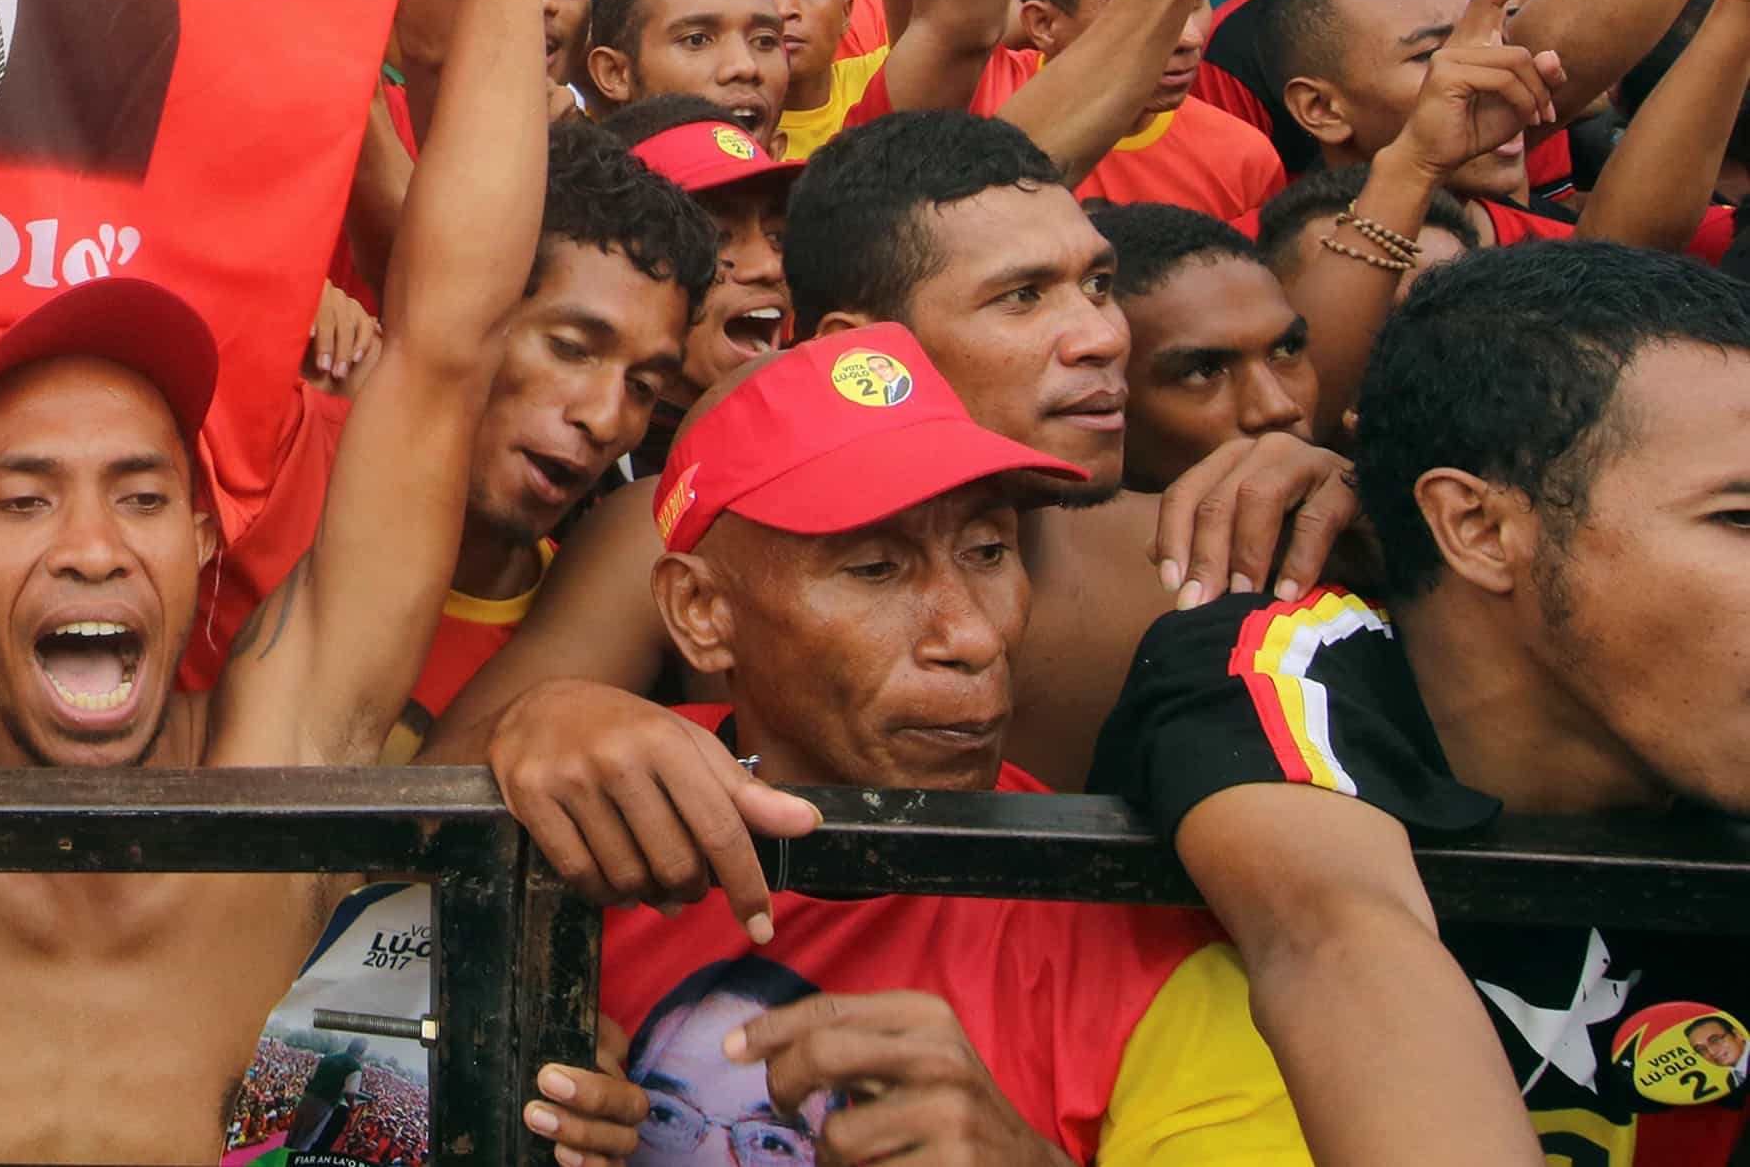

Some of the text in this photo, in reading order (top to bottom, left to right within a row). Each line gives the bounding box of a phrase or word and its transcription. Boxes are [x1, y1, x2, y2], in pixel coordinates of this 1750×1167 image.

[856, 378, 880, 397] 2
[361, 950, 413, 971] 2017
[1648, 1045, 1688, 1069] VOTA
[1678, 1069, 1720, 1102] 2
